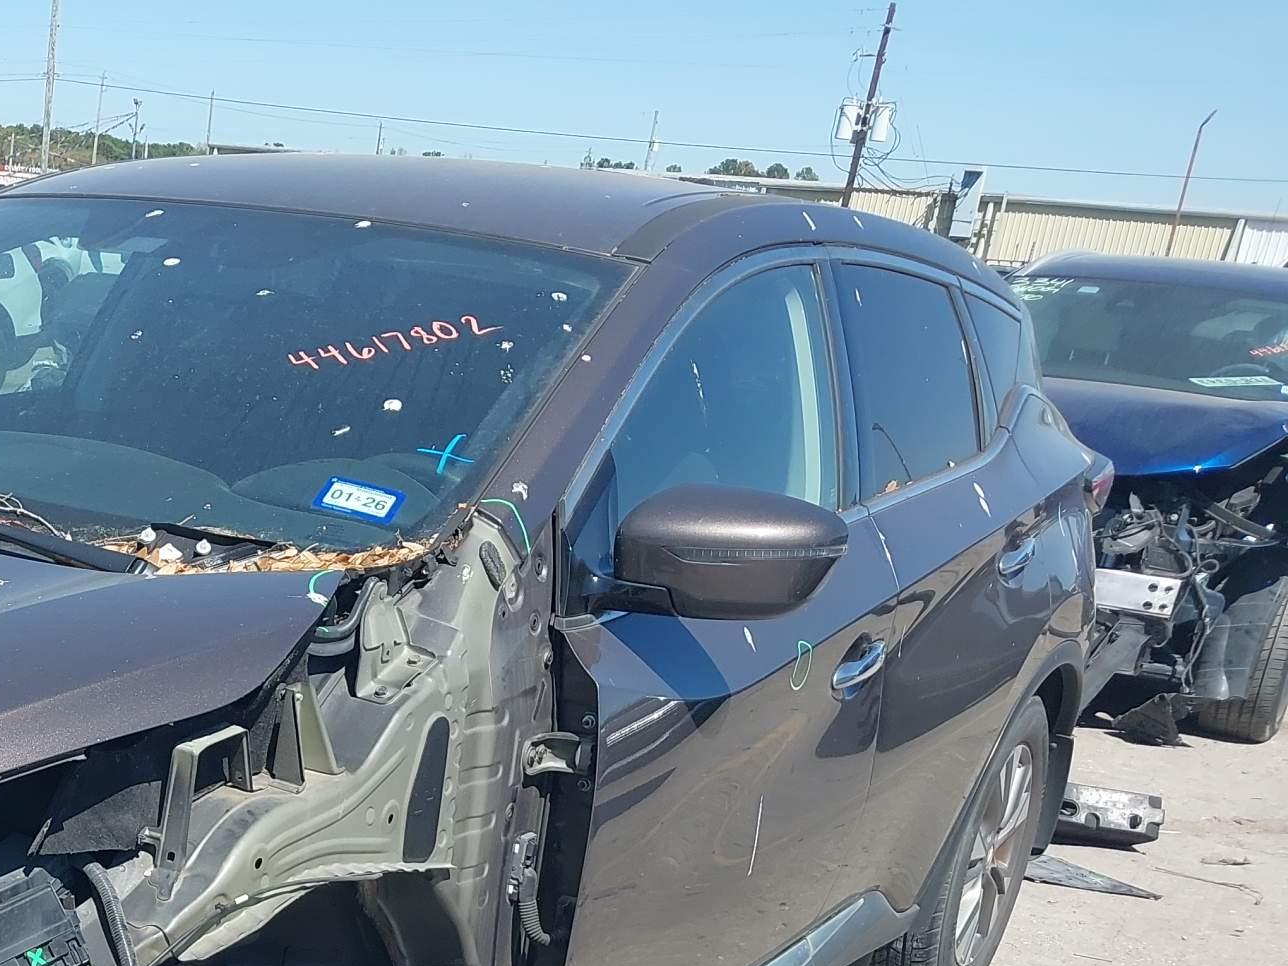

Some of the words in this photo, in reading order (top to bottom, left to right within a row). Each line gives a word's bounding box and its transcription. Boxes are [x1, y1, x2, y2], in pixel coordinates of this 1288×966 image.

[287, 315, 505, 370] 44617802
[330, 489, 354, 502] 01
[361, 496, 388, 511] 26
